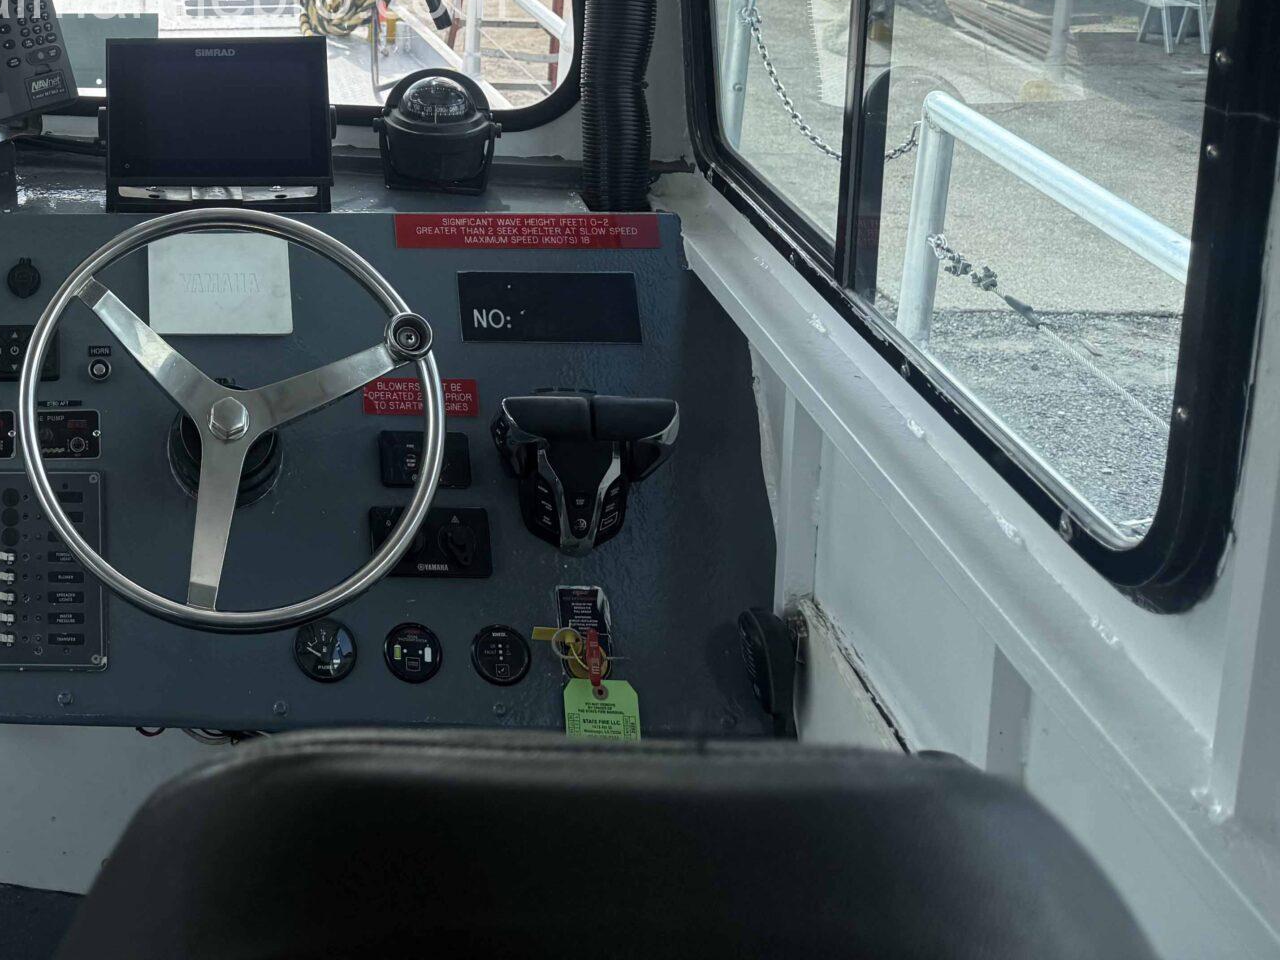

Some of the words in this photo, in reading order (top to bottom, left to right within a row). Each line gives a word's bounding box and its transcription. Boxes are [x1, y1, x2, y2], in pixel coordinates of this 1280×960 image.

[195, 49, 235, 57] SIMRAD
[442, 218, 493, 228] SIGNIFICANT
[497, 218, 521, 228] WAVE
[524, 218, 555, 228] HEIGHT
[558, 218, 587, 228] (FEET)
[590, 218, 609, 228] 0-2
[416, 227, 459, 236] GREATER
[461, 227, 485, 236] THAN
[487, 227, 493, 236] 2
[496, 227, 519, 236] SEEK
[521, 227, 561, 236] SHELTER
[564, 227, 576, 236] AT
[580, 227, 606, 236] SLOW
[609, 227, 638, 236] SPEED
[464, 235, 508, 245] MAXIMUM
[511, 235, 539, 245] SPEED
[542, 235, 577, 245] (KNOTS)
[581, 235, 590, 245] 18
[179, 273, 261, 293] YAMAHA
[473, 309, 512, 329] NO:
[90, 347, 109, 355] HORN
[376, 382, 421, 391] BLOWERS
[450, 383, 462, 392] BE
[368, 392, 415, 401] OPERATED
[445, 393, 473, 402] PRIOR
[374, 401, 387, 410] TO
